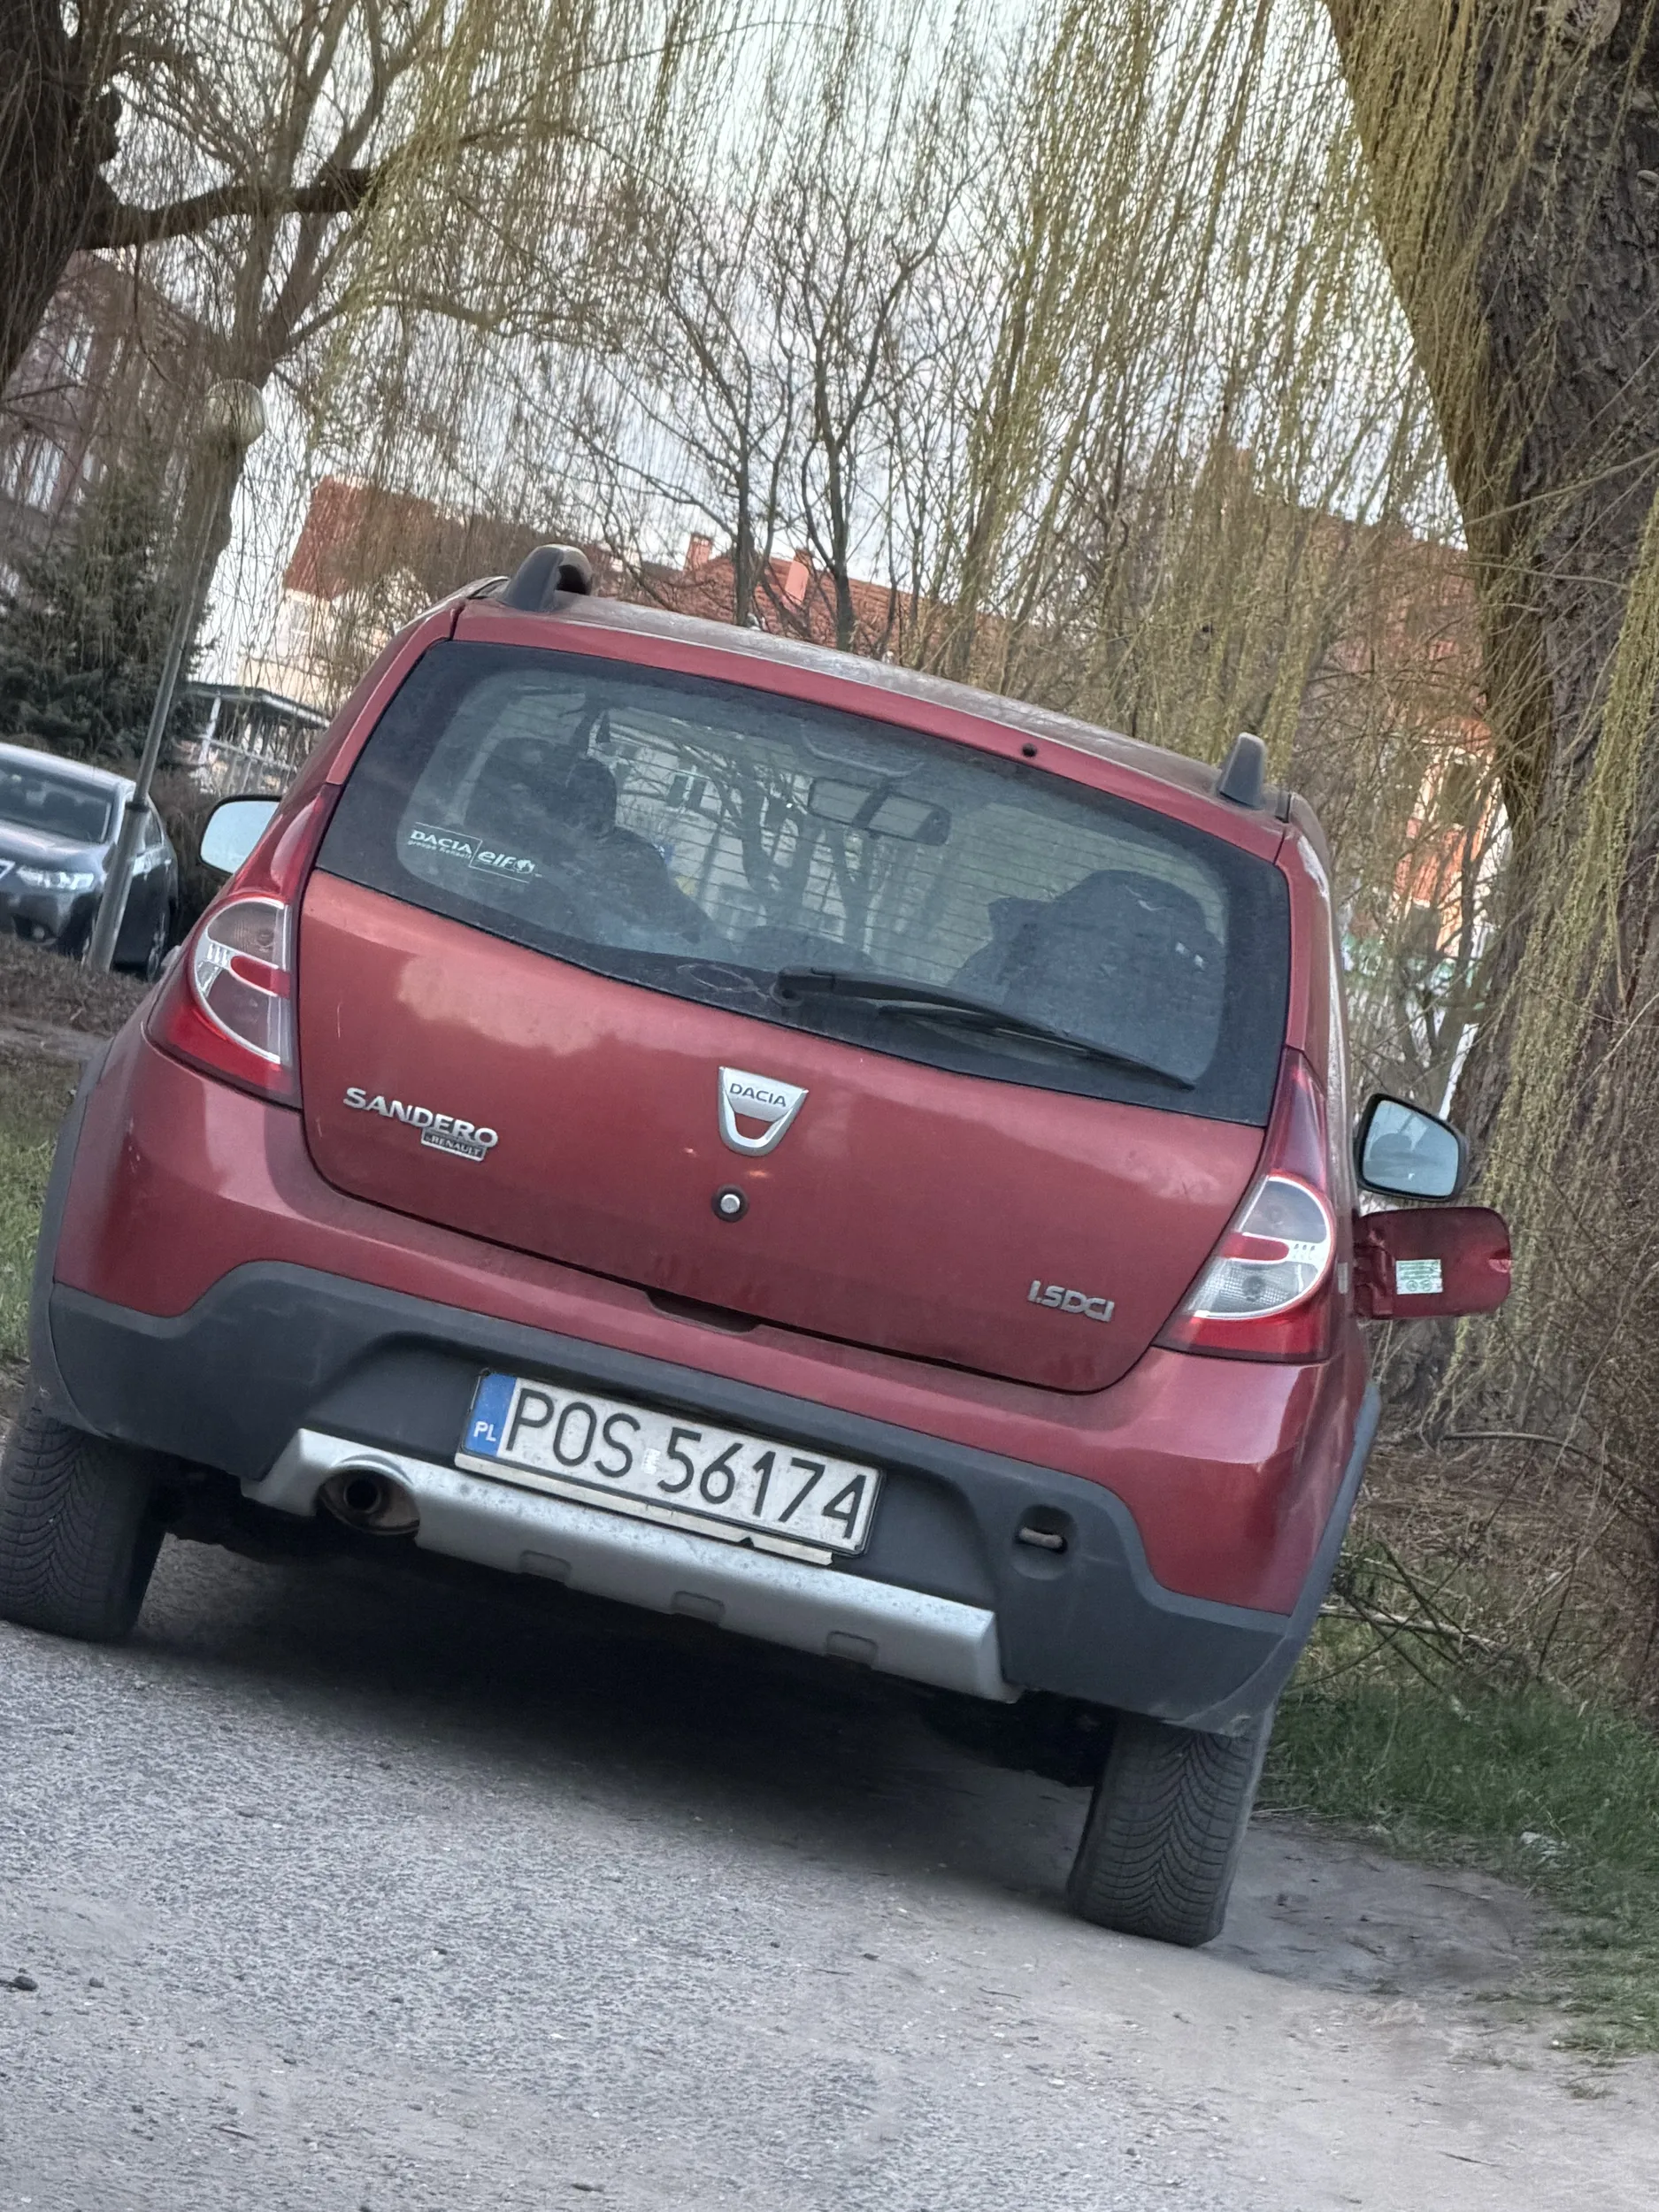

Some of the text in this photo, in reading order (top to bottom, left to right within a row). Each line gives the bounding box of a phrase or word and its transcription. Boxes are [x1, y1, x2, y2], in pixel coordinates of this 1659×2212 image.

[410, 830, 472, 854] DACIA
[477, 849, 517, 869] elf
[729, 1083, 786, 1107] DACIA
[343, 1087, 499, 1148] SANDERO
[431, 1135, 480, 1156] RENAULT
[473, 1421, 496, 1442] PL
[505, 1388, 867, 1540] POS 56174
